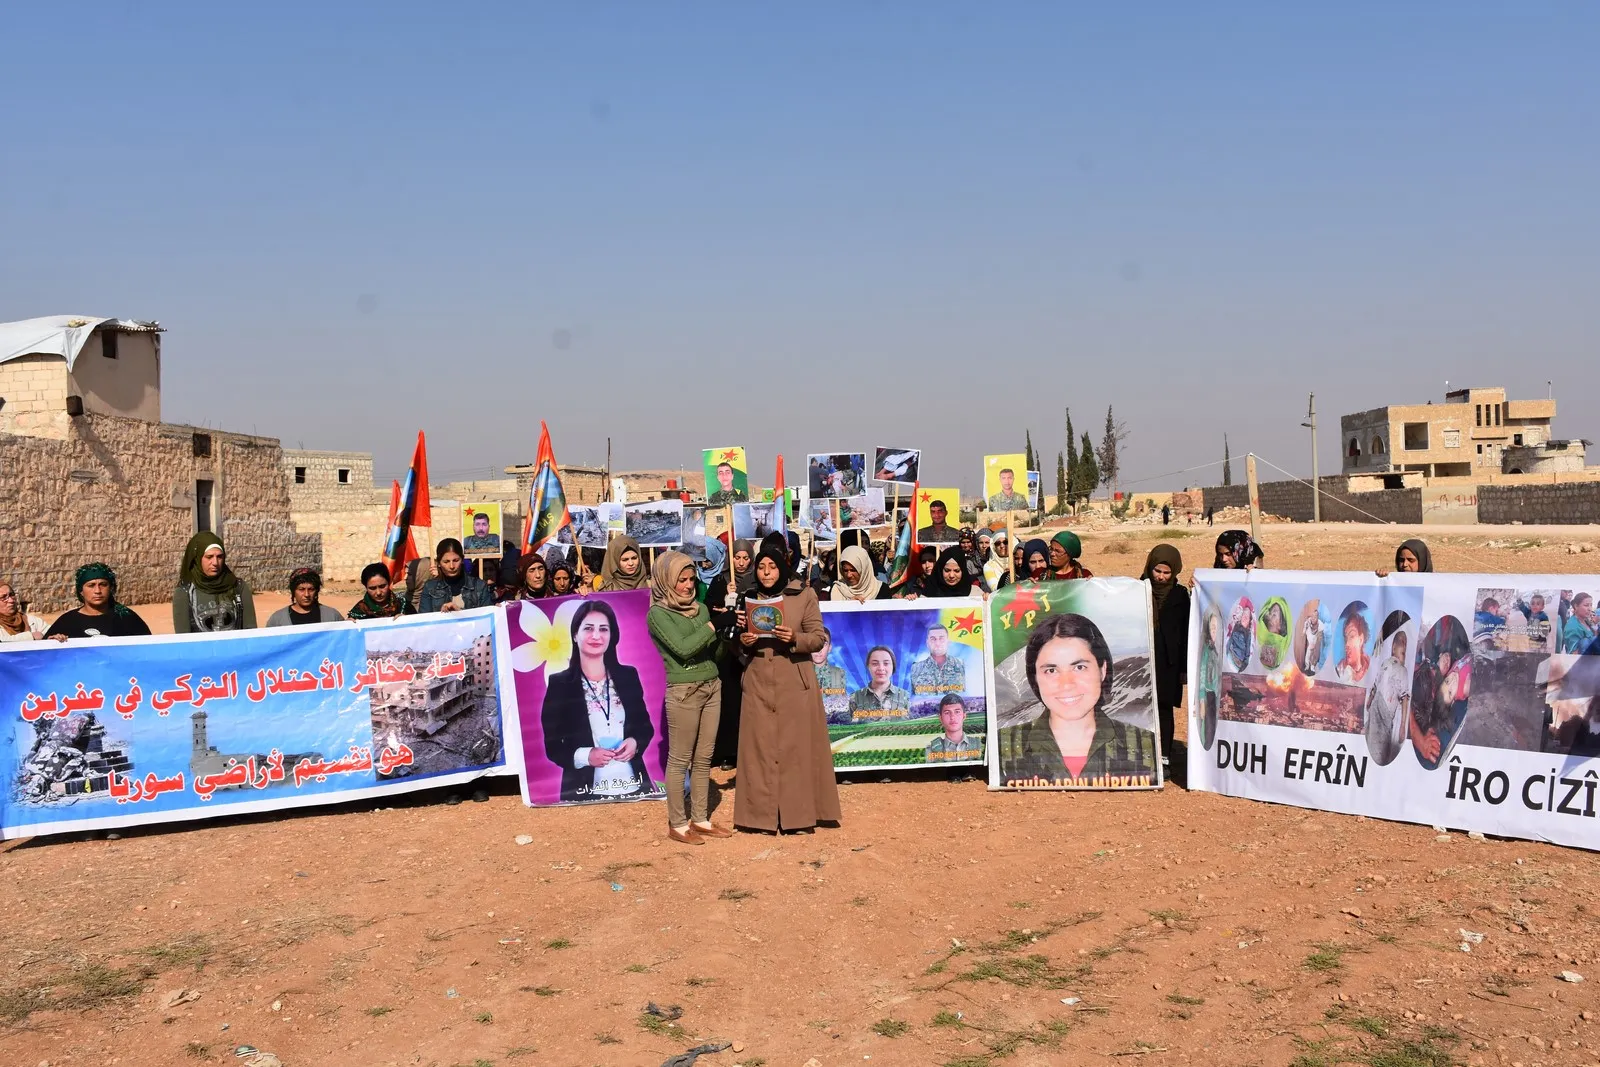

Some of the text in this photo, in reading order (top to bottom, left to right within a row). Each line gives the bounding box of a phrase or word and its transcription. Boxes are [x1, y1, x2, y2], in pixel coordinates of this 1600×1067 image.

[948, 620, 982, 638] YPG
[1000, 594, 1051, 630] YPJ
[20, 652, 466, 721] بناء مخافر الأحتلال التركي في عفرين
[107, 743, 415, 804] هو تقسيم لأراضي سوريا
[576, 779, 608, 795] الفرات
[1217, 739, 1368, 787] DUH EFRÎN
[1445, 755, 1510, 805] ÎRO
